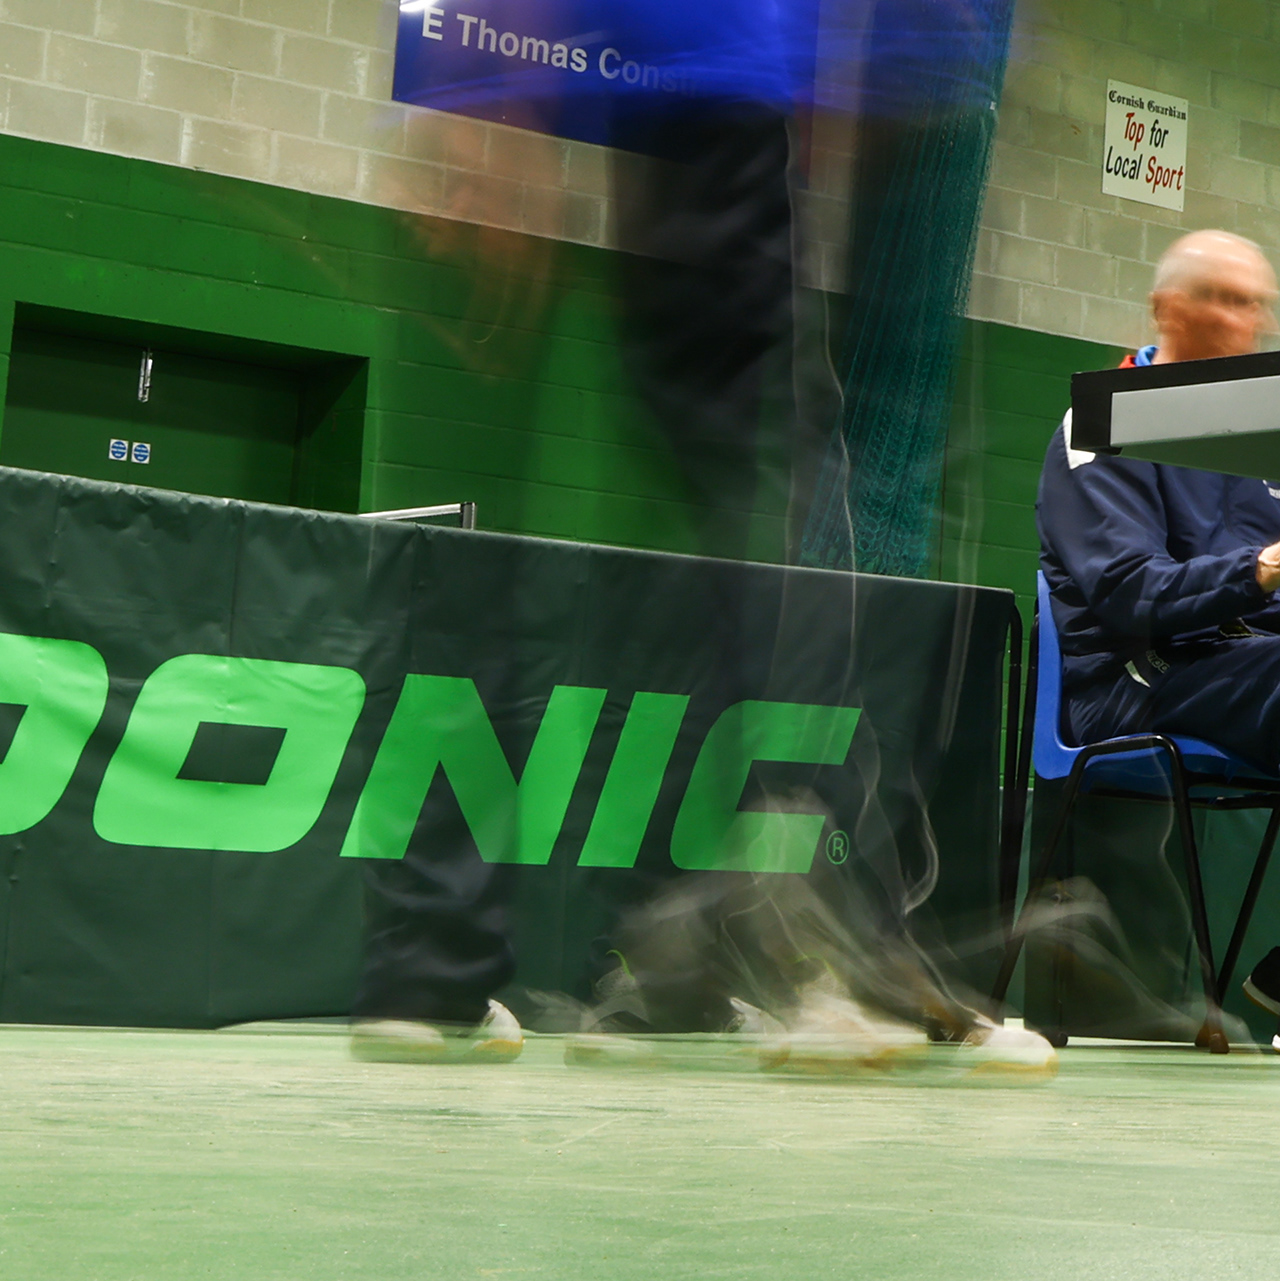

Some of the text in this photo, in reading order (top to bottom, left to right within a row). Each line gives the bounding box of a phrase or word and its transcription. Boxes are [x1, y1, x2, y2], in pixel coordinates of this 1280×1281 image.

[421, 5, 445, 40] E
[456, 14, 588, 73] Thomas
[1108, 89, 1186, 120] Cornish Guardian
[1124, 112, 1169, 151] Top for
[1105, 145, 1184, 194] Local Sport
